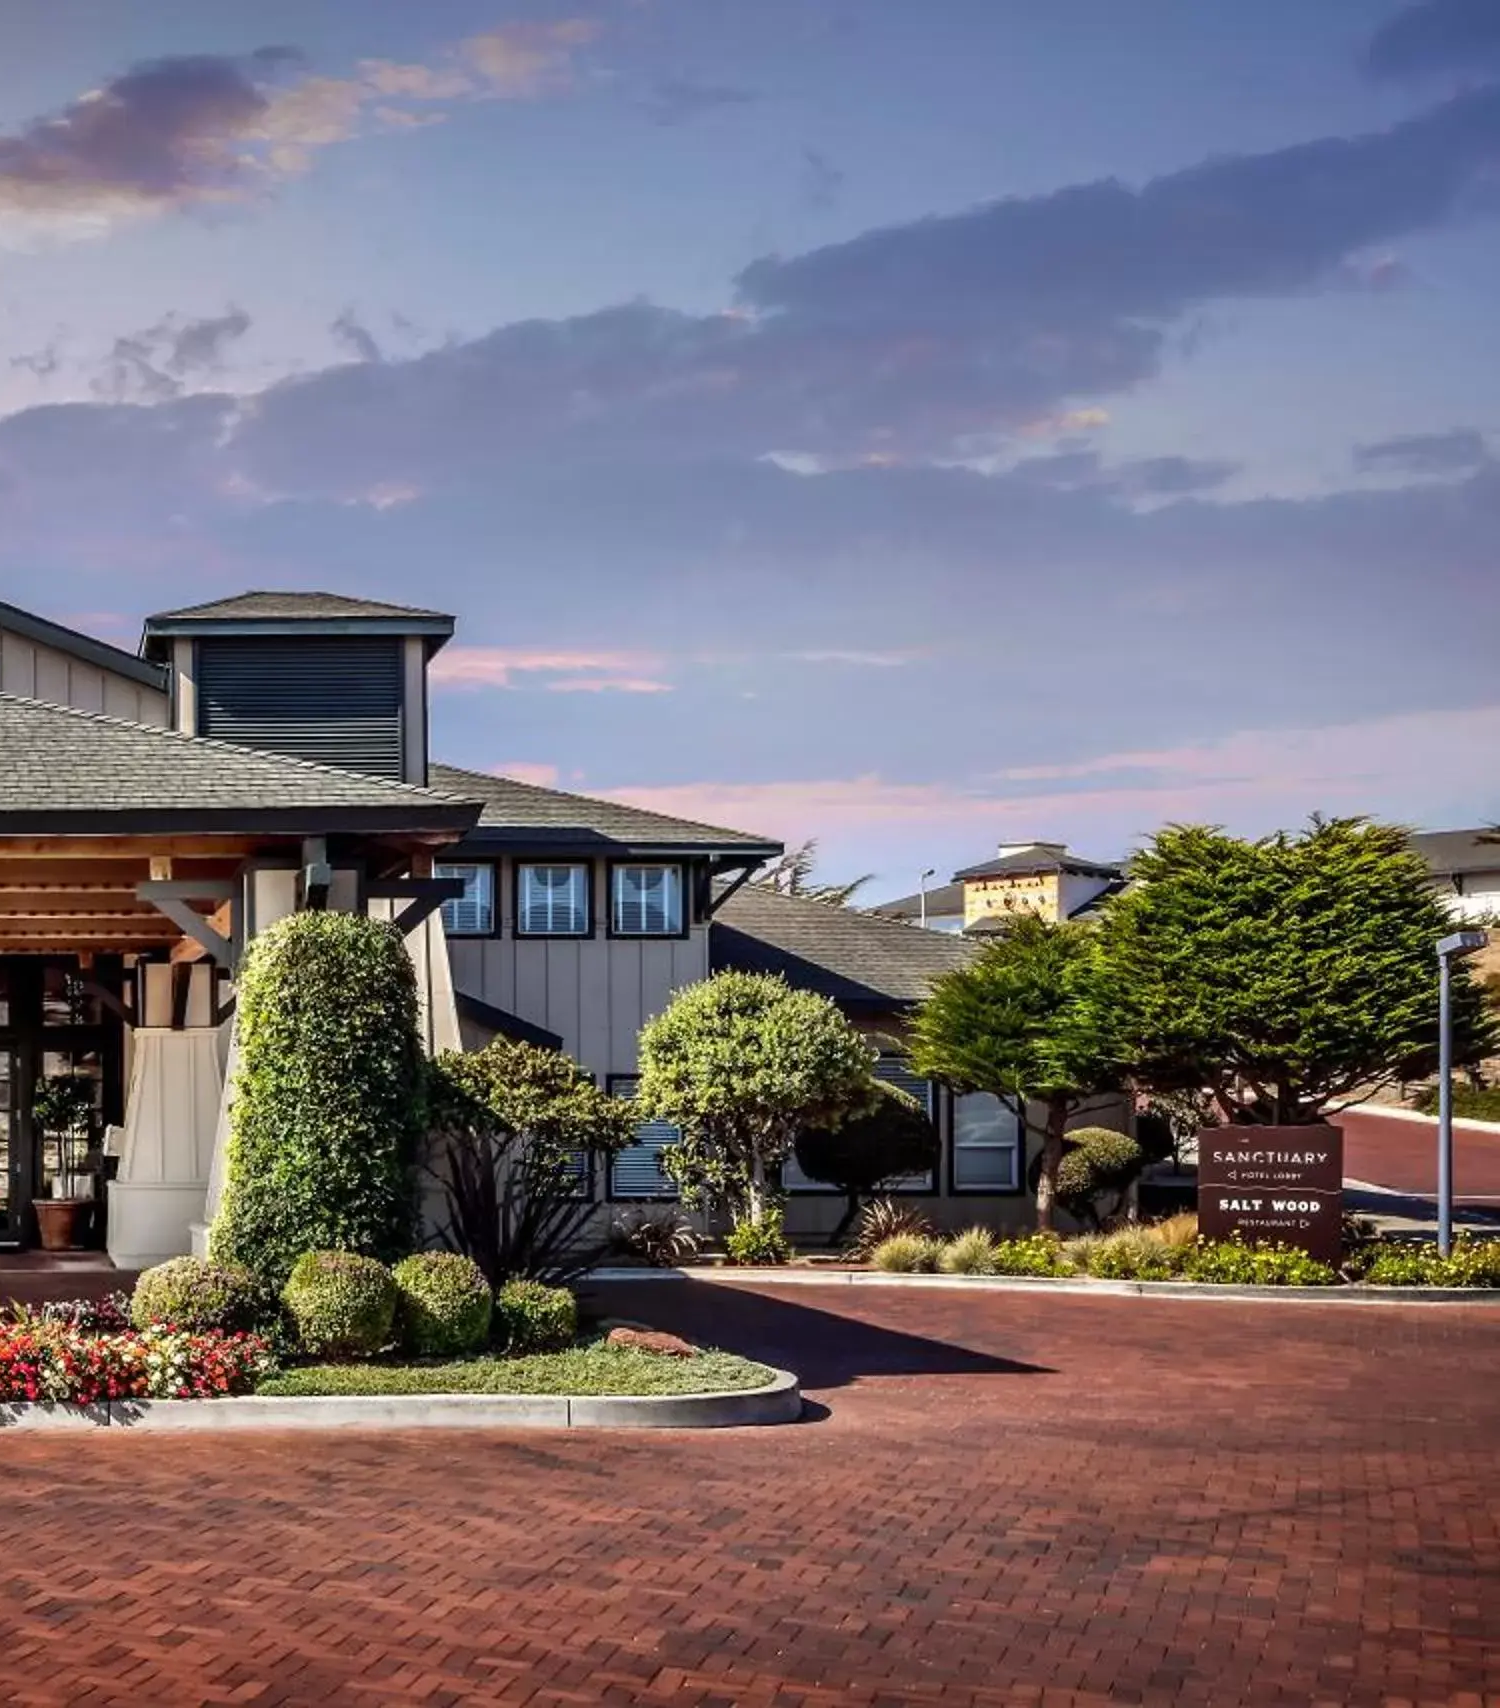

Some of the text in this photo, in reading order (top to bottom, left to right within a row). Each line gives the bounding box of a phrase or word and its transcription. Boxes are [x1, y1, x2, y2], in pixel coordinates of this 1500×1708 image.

[1213, 1151, 1328, 1164] SANCTUARY
[1241, 1172, 1269, 1180] HOTEL
[1219, 1199, 1321, 1212] SALT WOOD
